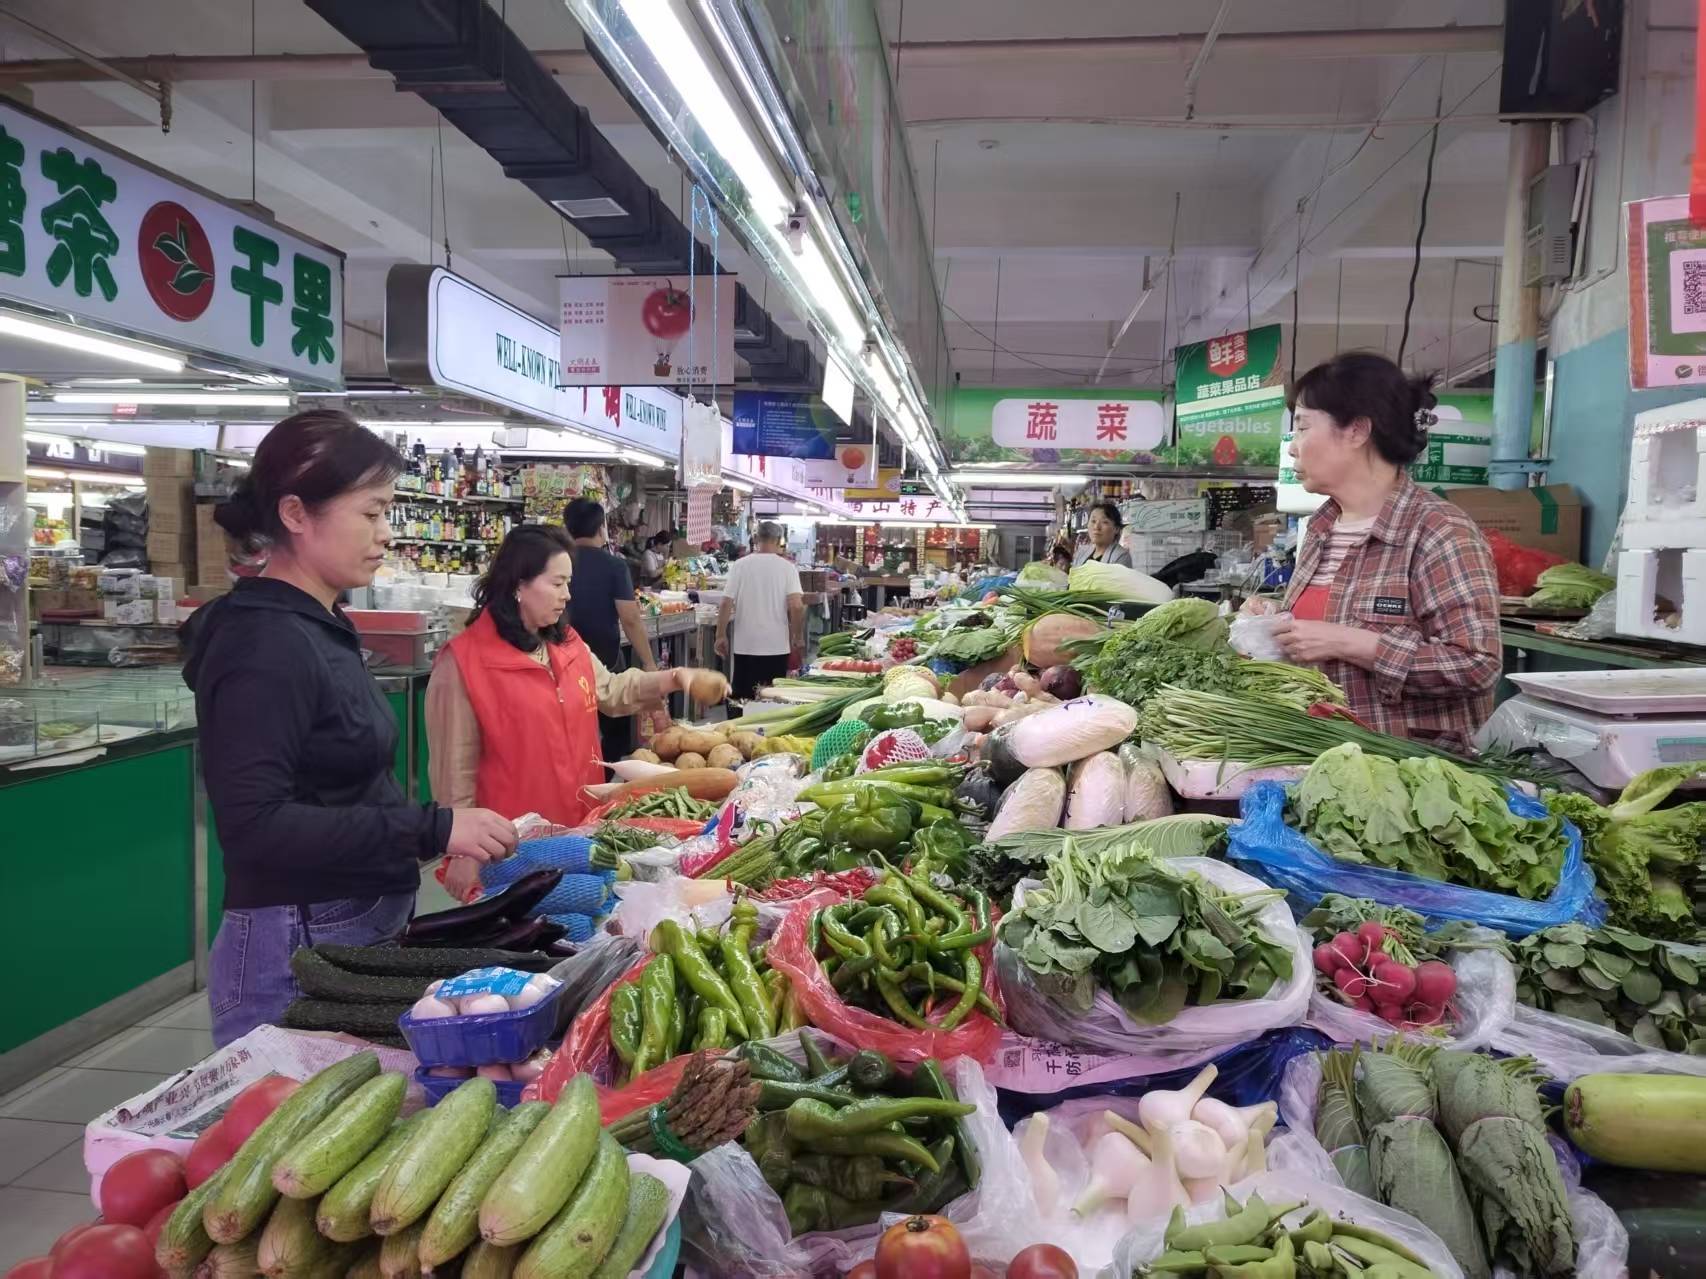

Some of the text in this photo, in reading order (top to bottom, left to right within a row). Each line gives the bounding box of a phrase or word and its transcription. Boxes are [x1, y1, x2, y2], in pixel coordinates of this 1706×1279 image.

[231, 225, 335, 365] 干果
[496, 333, 546, 385] WELL-KNOWN
[1196, 375, 1260, 399] 蔬菜果品店
[1026, 402, 1129, 442] 蔬菜
